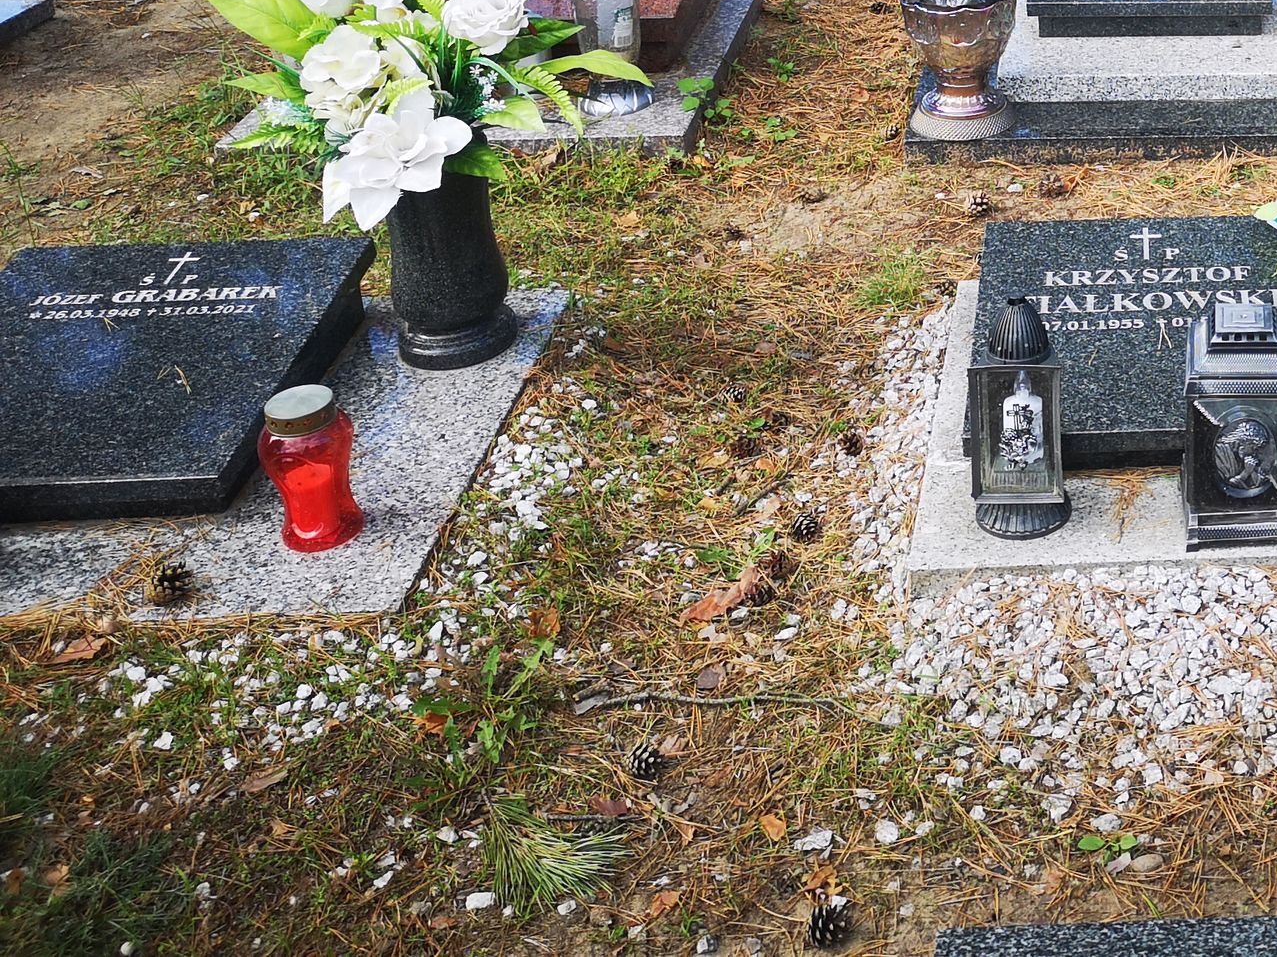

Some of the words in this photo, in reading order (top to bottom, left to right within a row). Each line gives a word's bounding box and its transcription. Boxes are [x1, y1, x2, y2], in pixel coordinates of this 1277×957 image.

[1114, 246, 1128, 261] Ś
[1164, 248, 1180, 260] P
[139, 272, 156, 286] Ś
[181, 274, 199, 285] P
[1043, 266, 1251, 287] KRZYSZTOF
[29, 292, 104, 307] JÓZEF
[111, 286, 284, 304] GRABAREK
